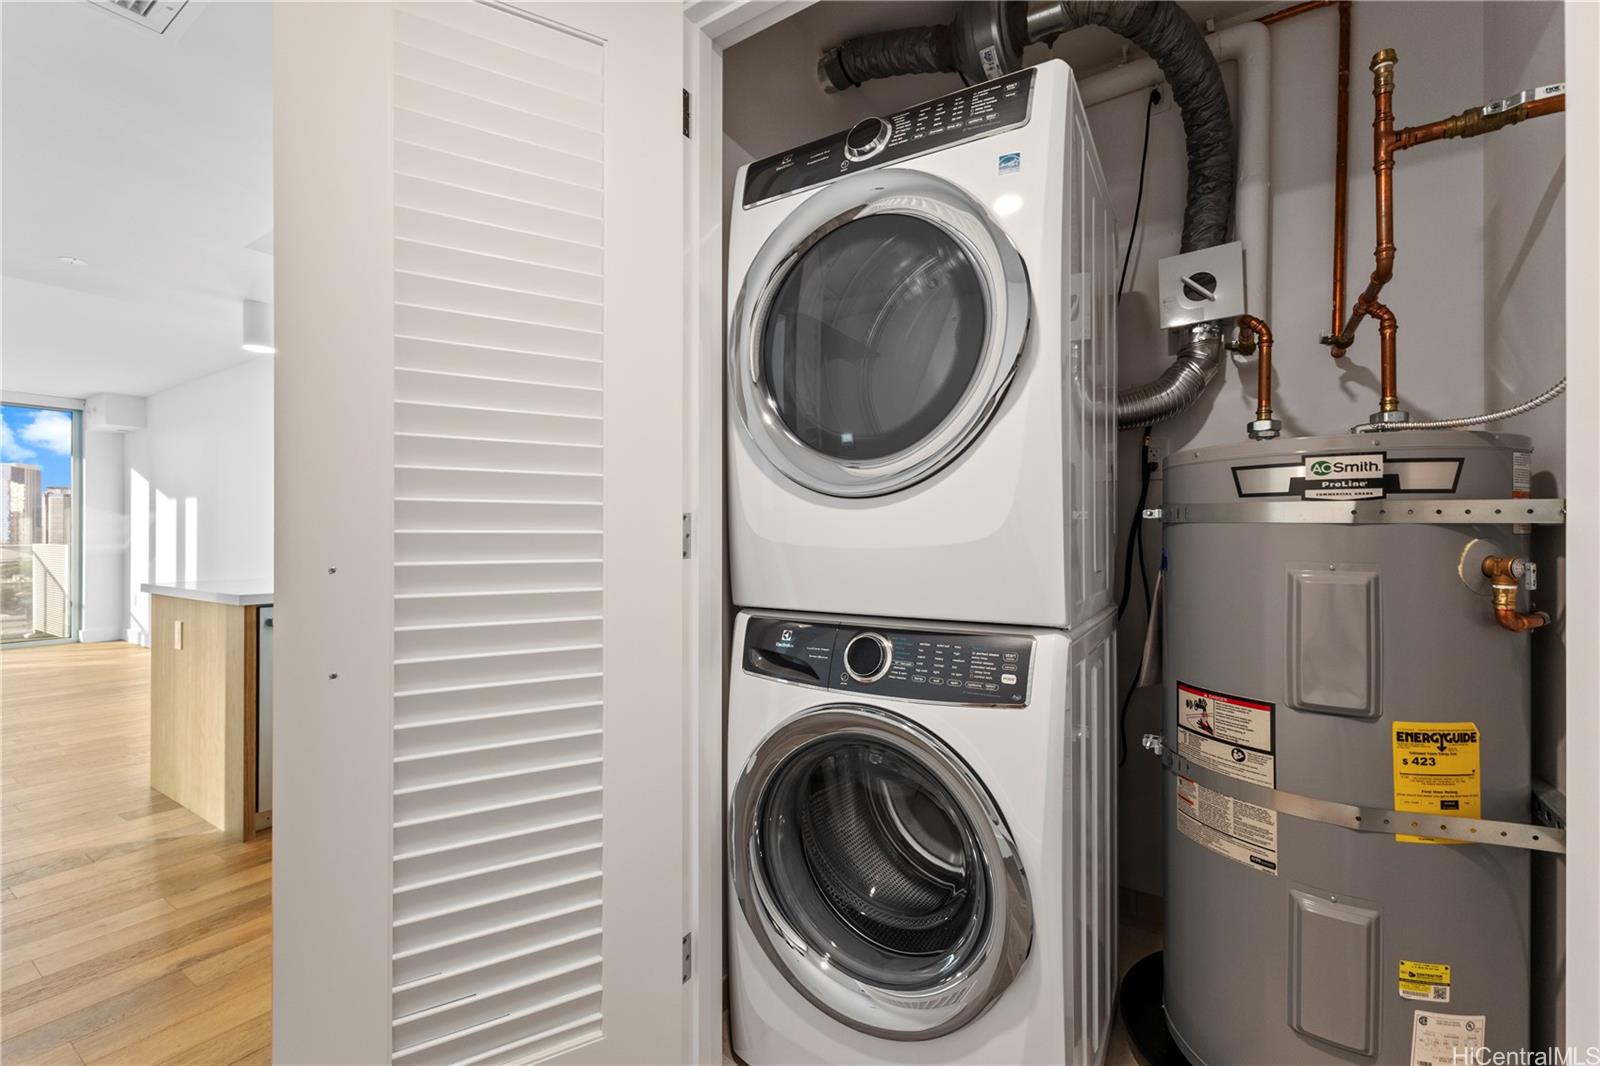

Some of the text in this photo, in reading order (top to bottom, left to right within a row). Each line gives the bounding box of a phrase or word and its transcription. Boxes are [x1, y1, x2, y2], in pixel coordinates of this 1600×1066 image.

[1321, 480, 1367, 488] ProLine
[1396, 731, 1477, 743] ENERGYGUIDE
[1412, 756, 1436, 766] 423
